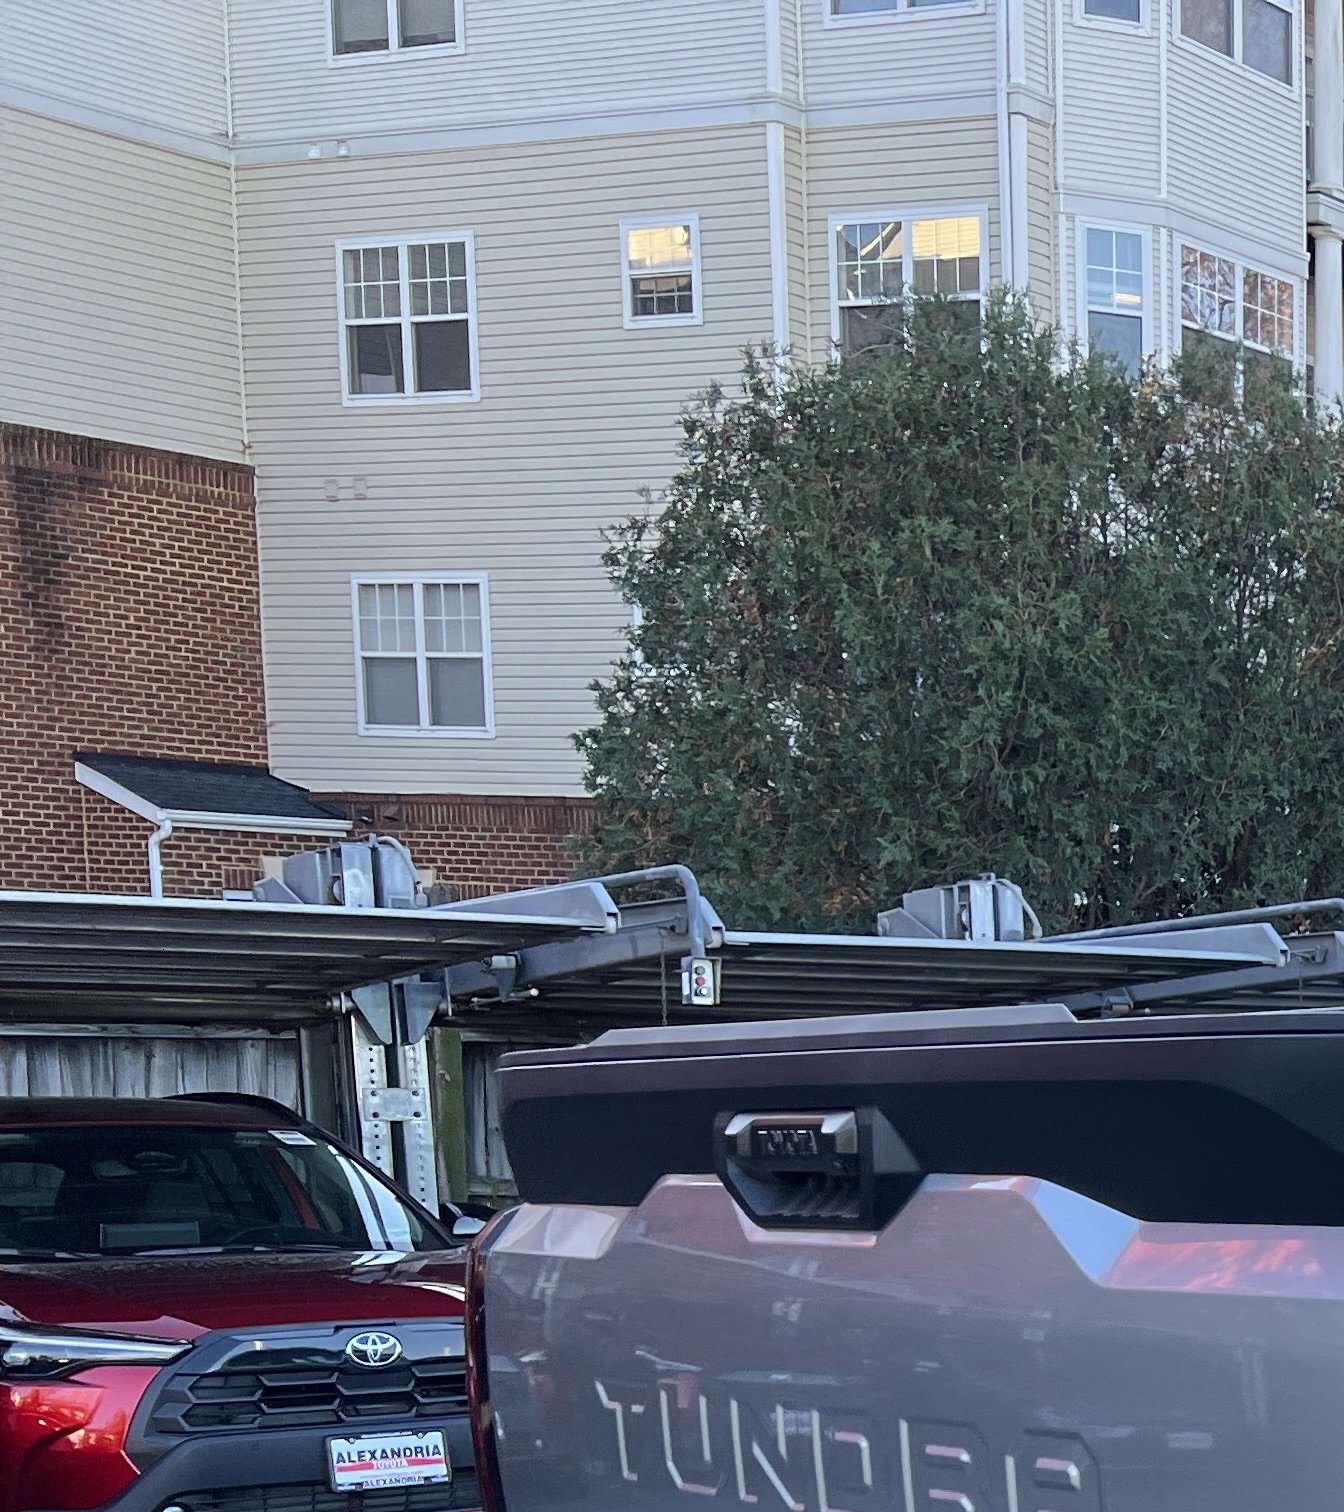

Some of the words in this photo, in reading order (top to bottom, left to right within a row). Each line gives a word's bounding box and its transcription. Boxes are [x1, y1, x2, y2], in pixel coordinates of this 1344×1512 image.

[335, 1444, 442, 1465] ALEXANDRIA
[373, 1458, 409, 1470] TOYOTA
[363, 1476, 424, 1488] ALEXANDRIA
